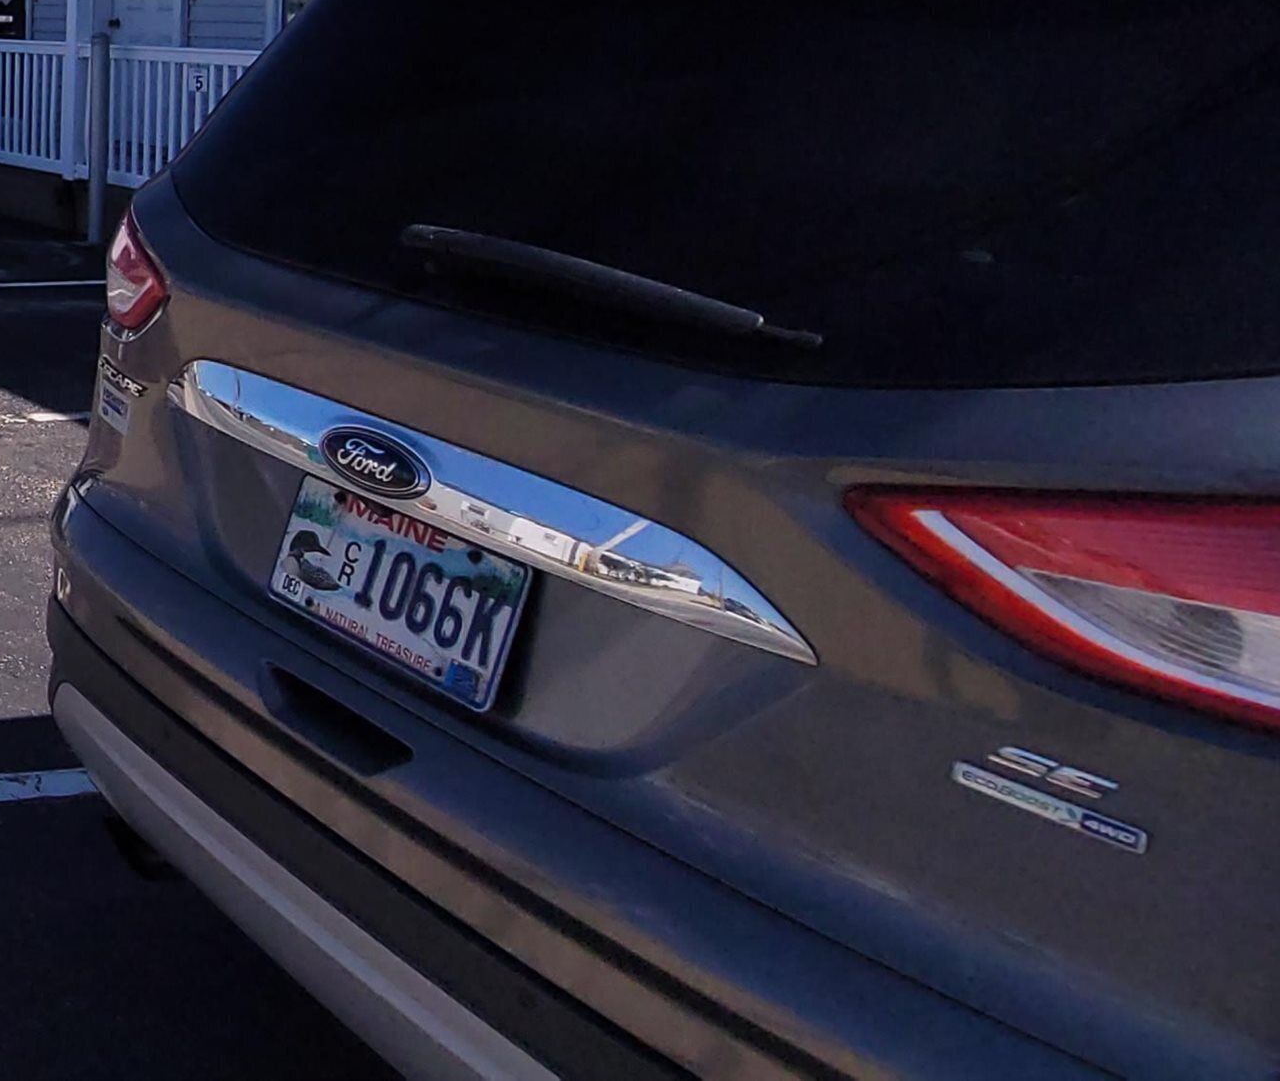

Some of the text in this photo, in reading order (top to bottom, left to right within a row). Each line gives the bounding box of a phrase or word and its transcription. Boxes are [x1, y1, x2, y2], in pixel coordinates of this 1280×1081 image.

[193, 75, 203, 92] 5
[337, 438, 397, 482] Ford
[344, 496, 452, 554] MAINE
[281, 572, 302, 597] DEC
[353, 539, 510, 668] 1066K
[325, 606, 371, 641] NATURAL
[375, 632, 433, 672] TREASURE
[987, 745, 1121, 800] SE
[1083, 819, 1137, 845] 4WD
